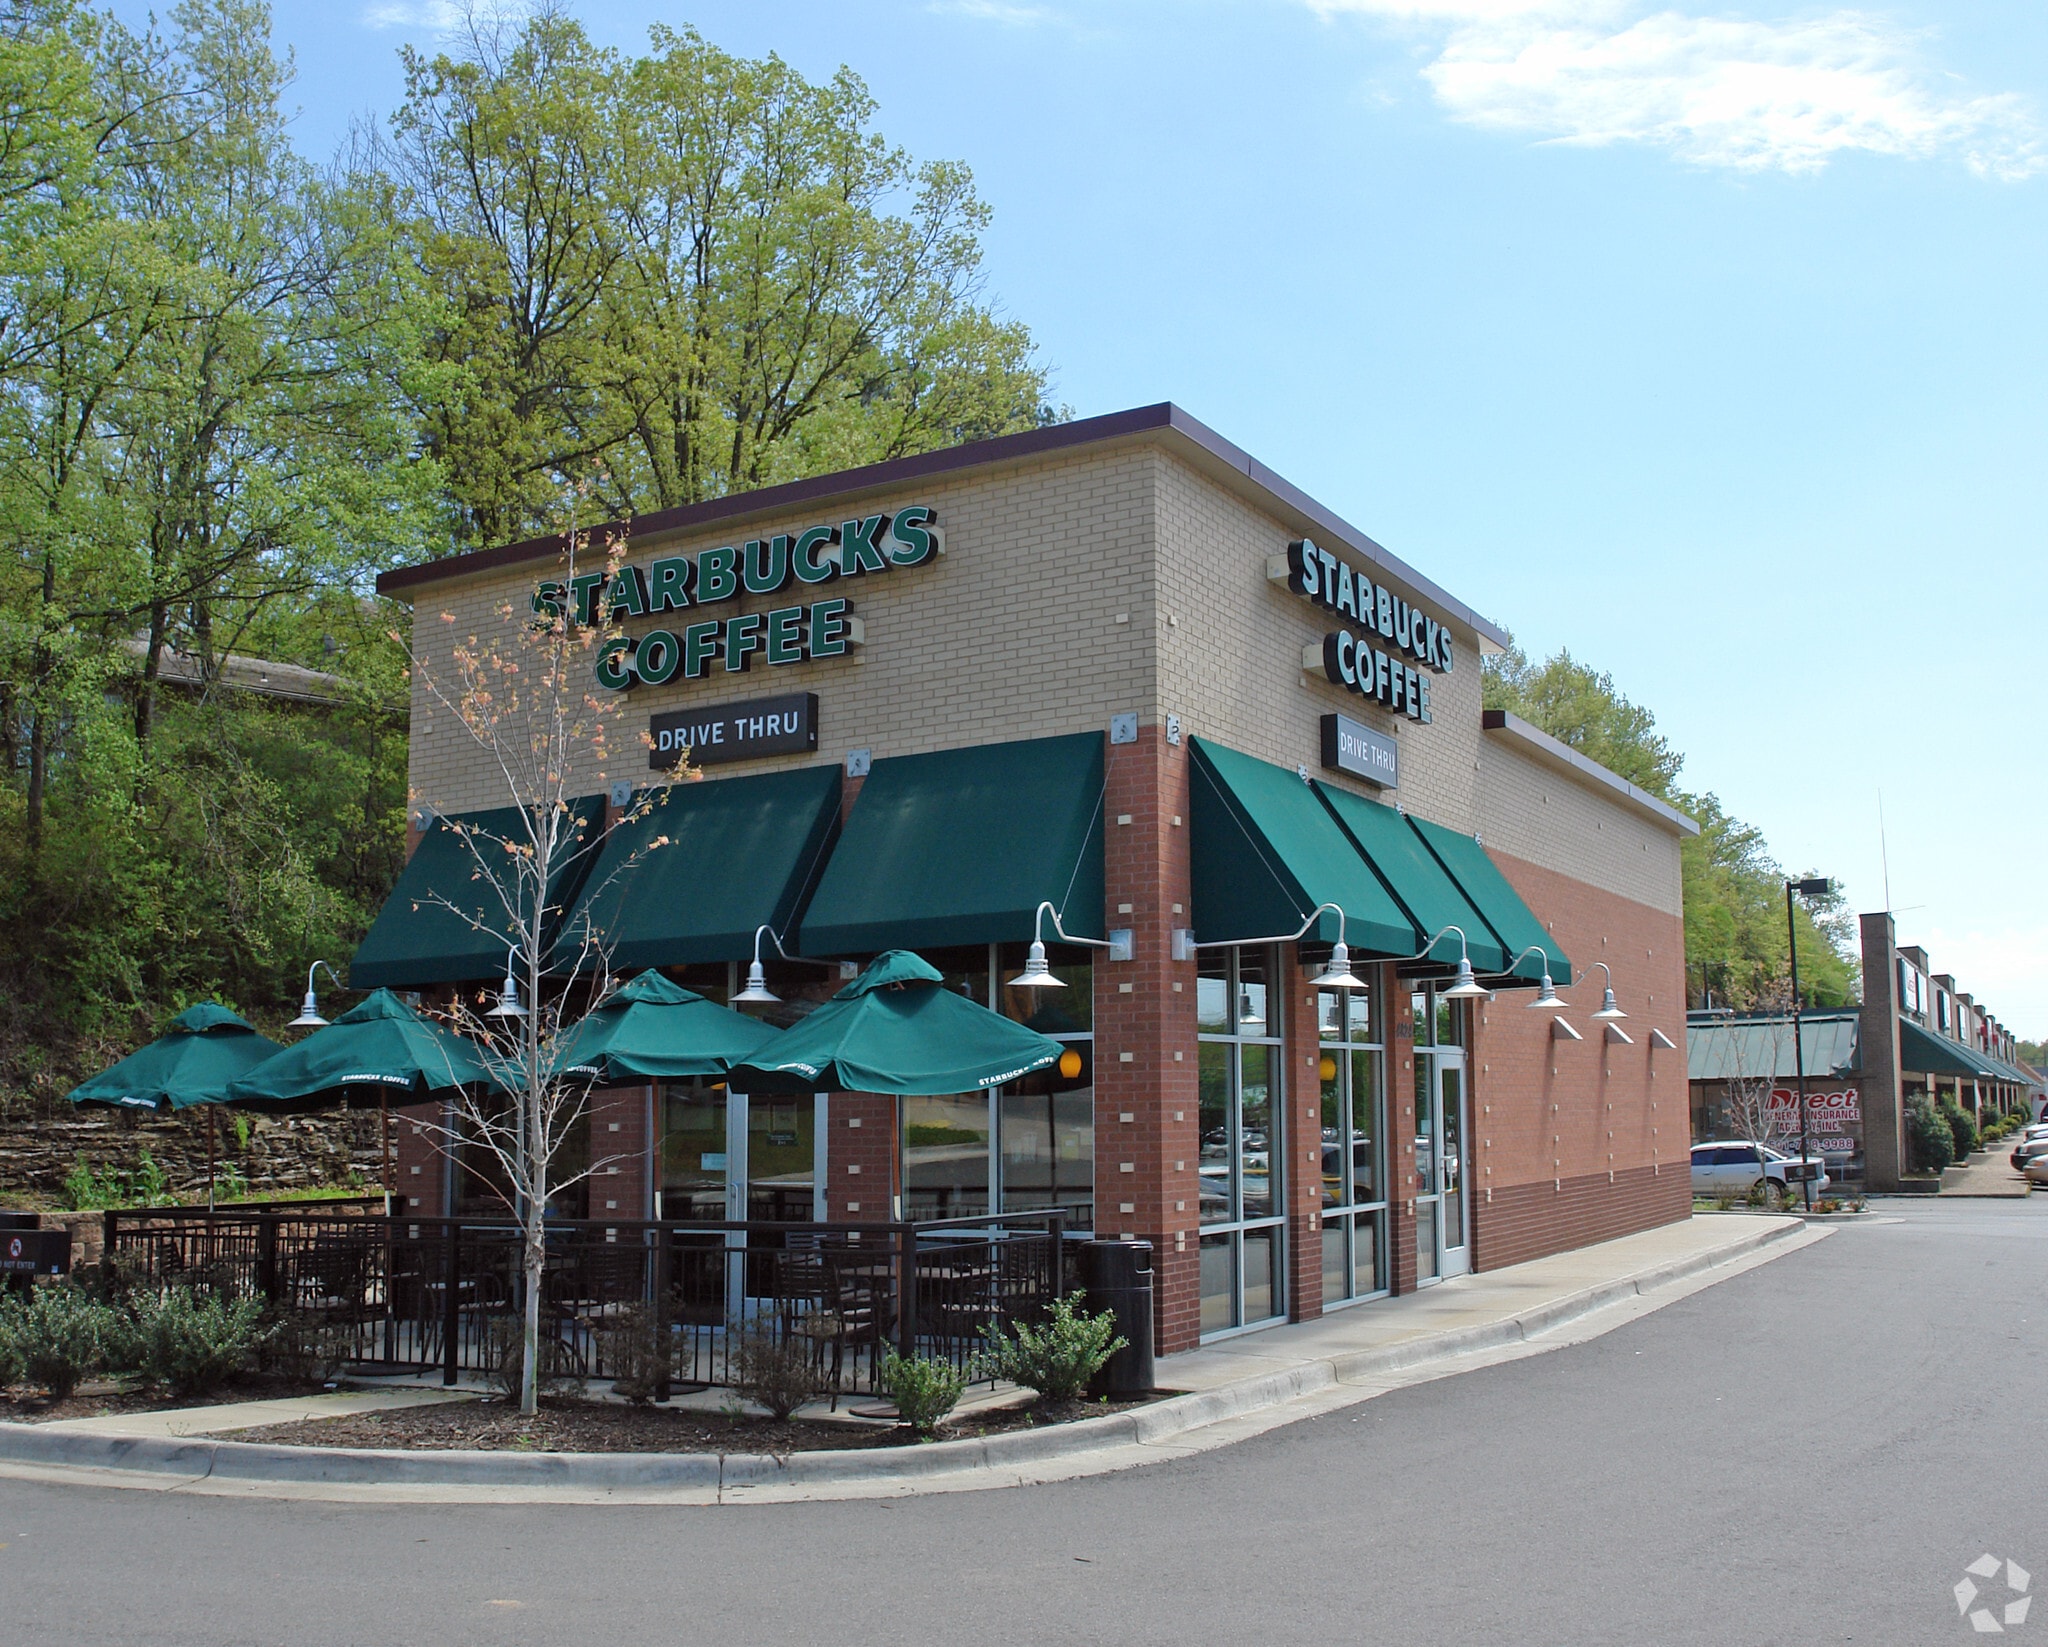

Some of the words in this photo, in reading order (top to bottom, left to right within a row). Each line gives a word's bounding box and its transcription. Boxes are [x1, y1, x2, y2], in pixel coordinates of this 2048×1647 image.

[530, 505, 937, 632] STARBUCKS
[1300, 538, 1453, 674] STARBUCKS
[596, 598, 852, 692] COFFEE
[1336, 630, 1432, 725] COFFEE
[658, 721, 725, 752] DRIVE
[735, 711, 799, 741] THRU
[1340, 731, 1368, 761] DRIVE
[1371, 744, 1395, 772] THRU
[1779, 1121, 1820, 1133] AGENY,
[1821, 1121, 1841, 1132] INC.
[1805, 1109, 1860, 1120] INSURANCE
[1767, 1138, 1854, 1150] 501-78-9988
